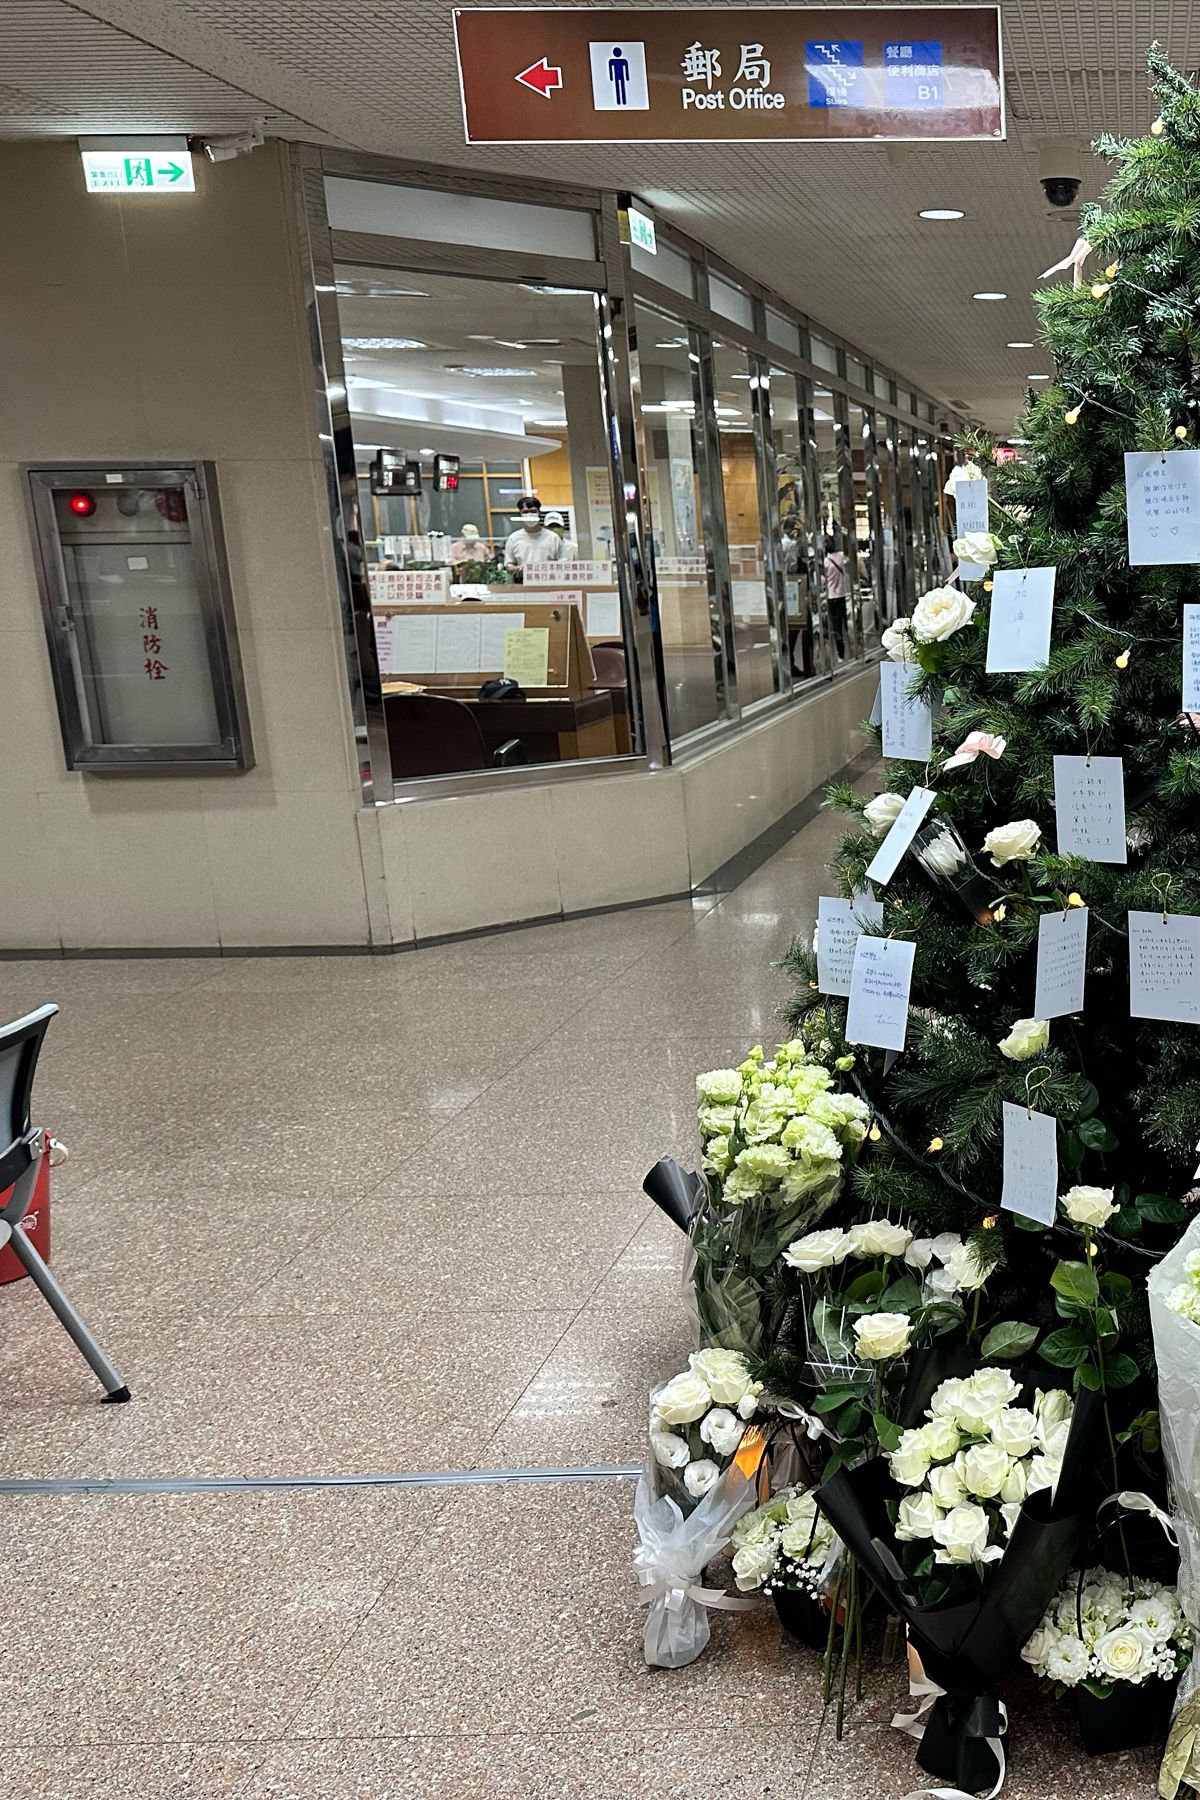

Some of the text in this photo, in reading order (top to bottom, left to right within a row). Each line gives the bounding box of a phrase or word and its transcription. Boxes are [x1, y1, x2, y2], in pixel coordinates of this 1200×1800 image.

[886, 45, 912, 58] 餐廳
[680, 41, 771, 90] 郵局
[887, 64, 940, 77] 便利商店
[682, 88, 785, 110] Post Office
[917, 85, 939, 101] B1
[138, 606, 170, 681] 消防栓
